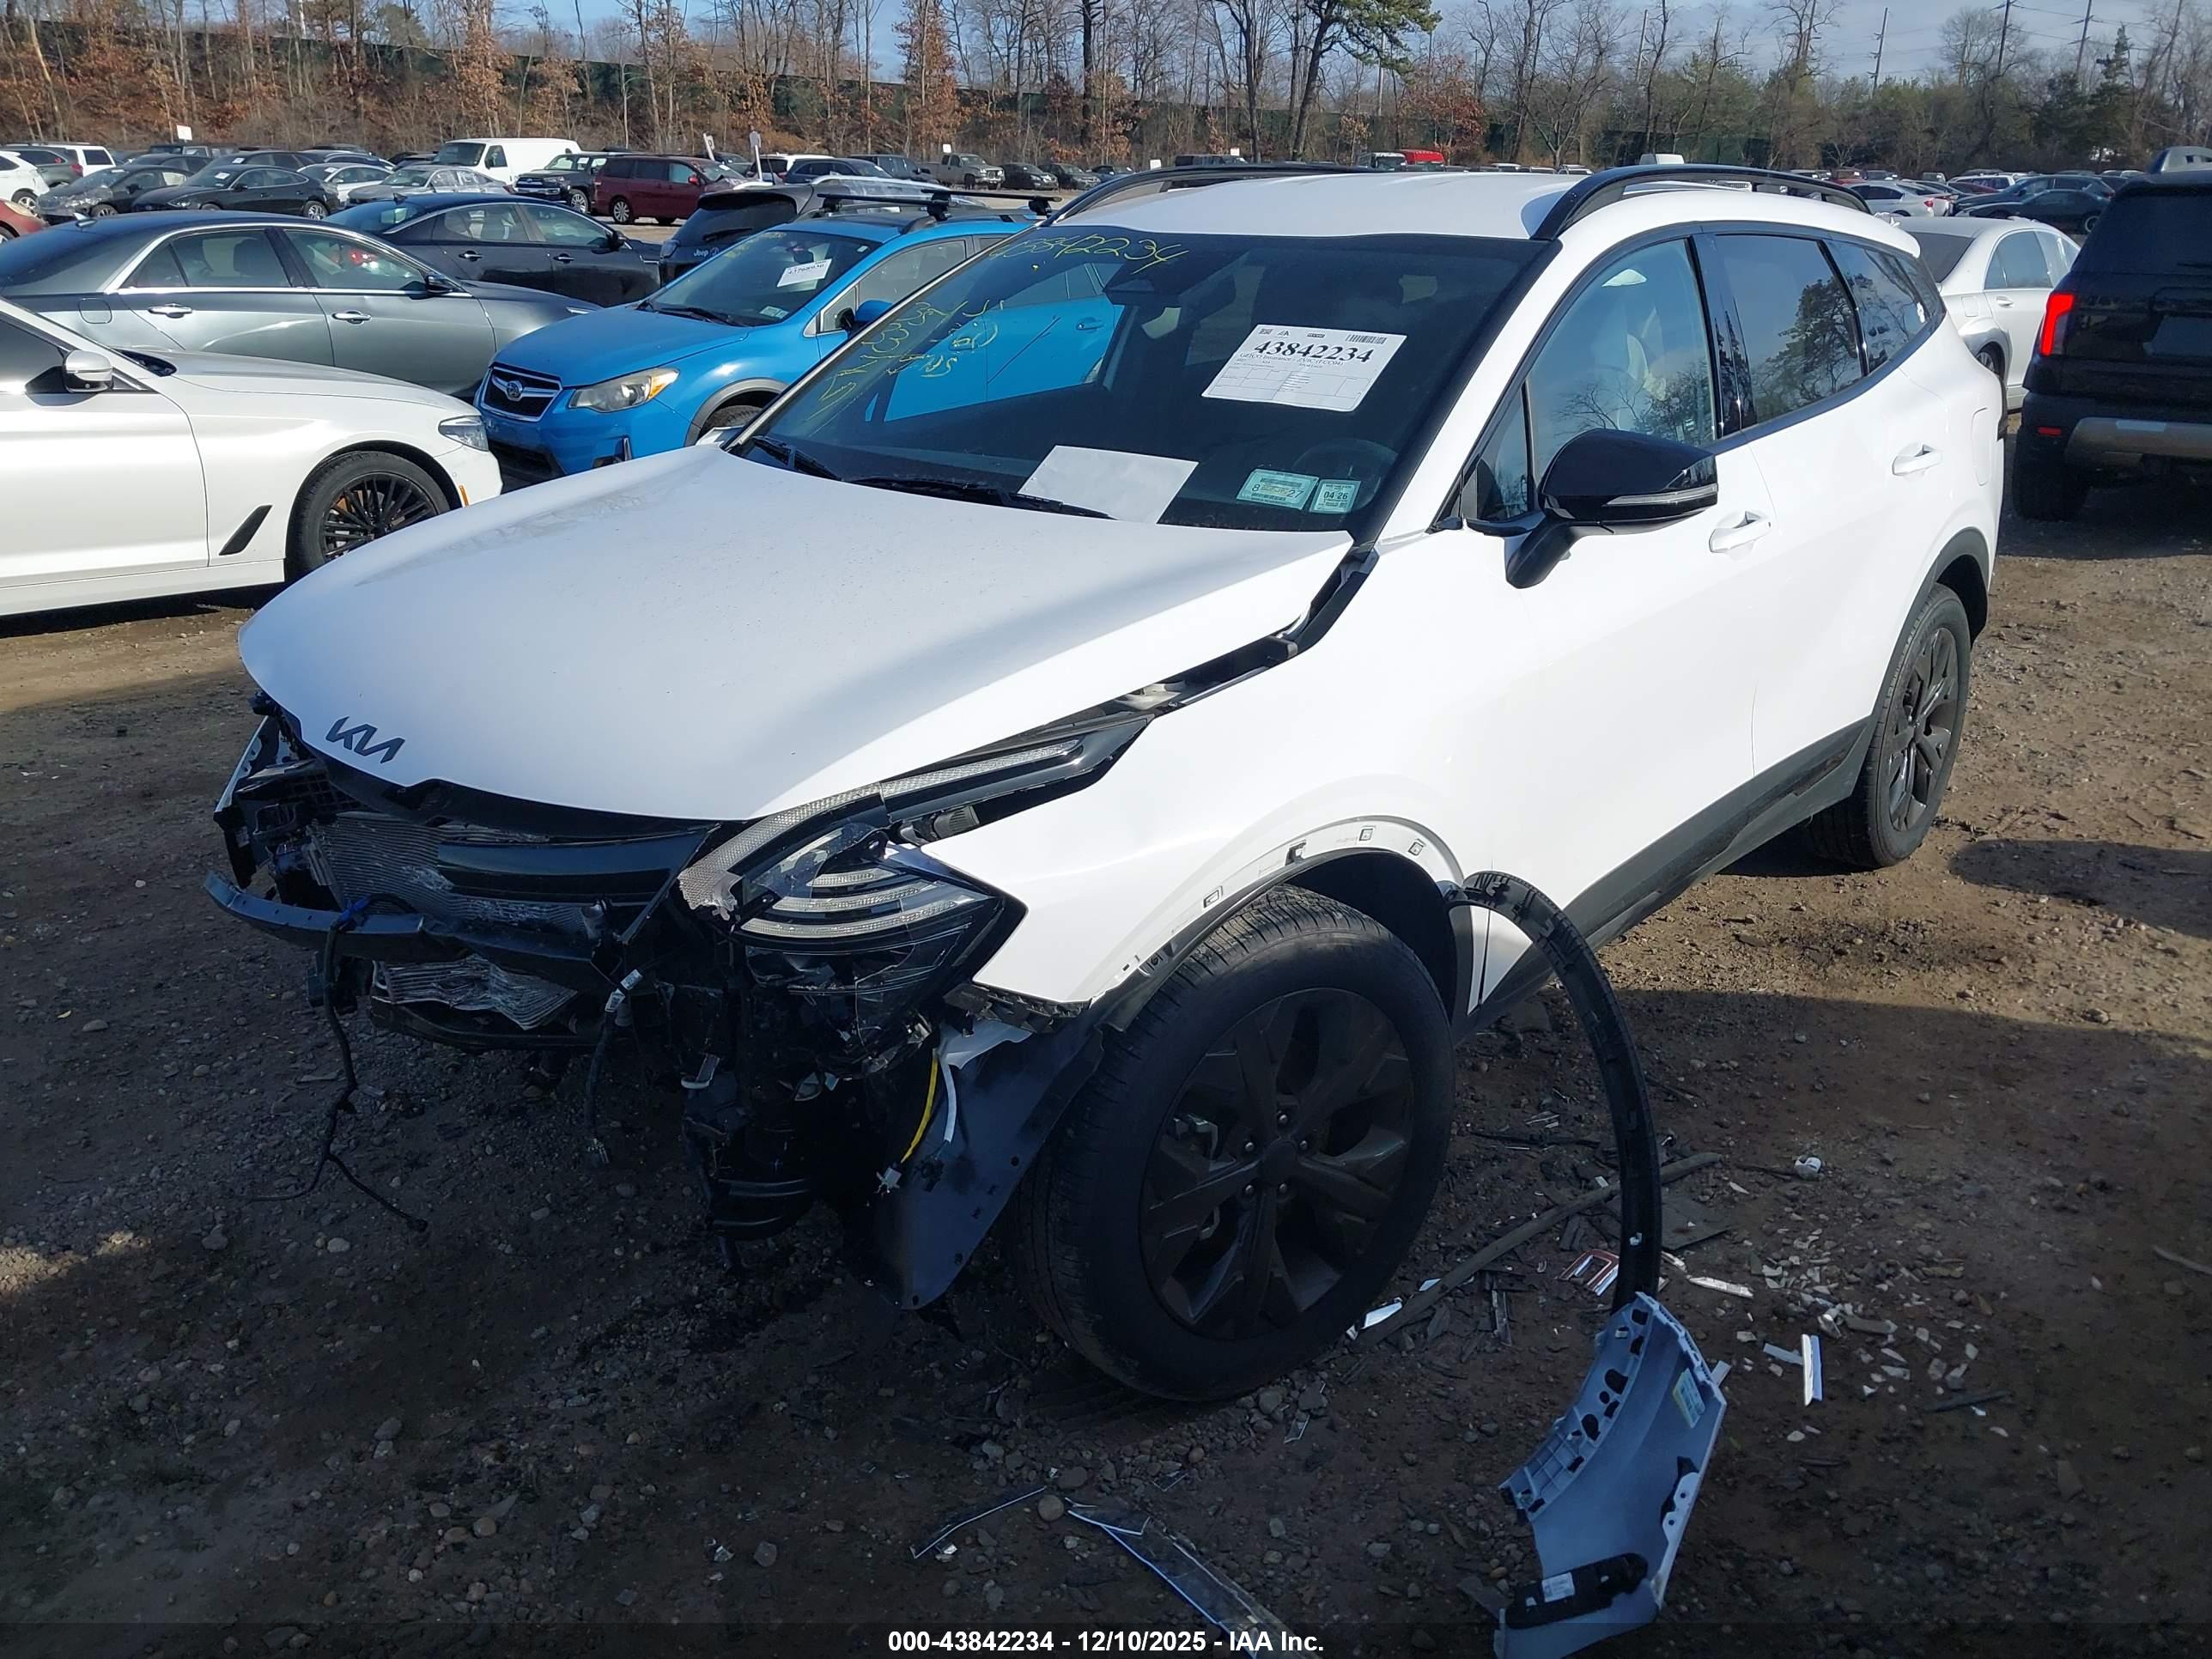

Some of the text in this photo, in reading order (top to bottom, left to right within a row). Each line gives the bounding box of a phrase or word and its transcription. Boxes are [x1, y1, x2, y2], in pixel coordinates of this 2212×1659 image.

[1255, 341, 1374, 362] 43842234
[1252, 483, 1261, 492] 8
[1287, 489, 1305, 499] 27
